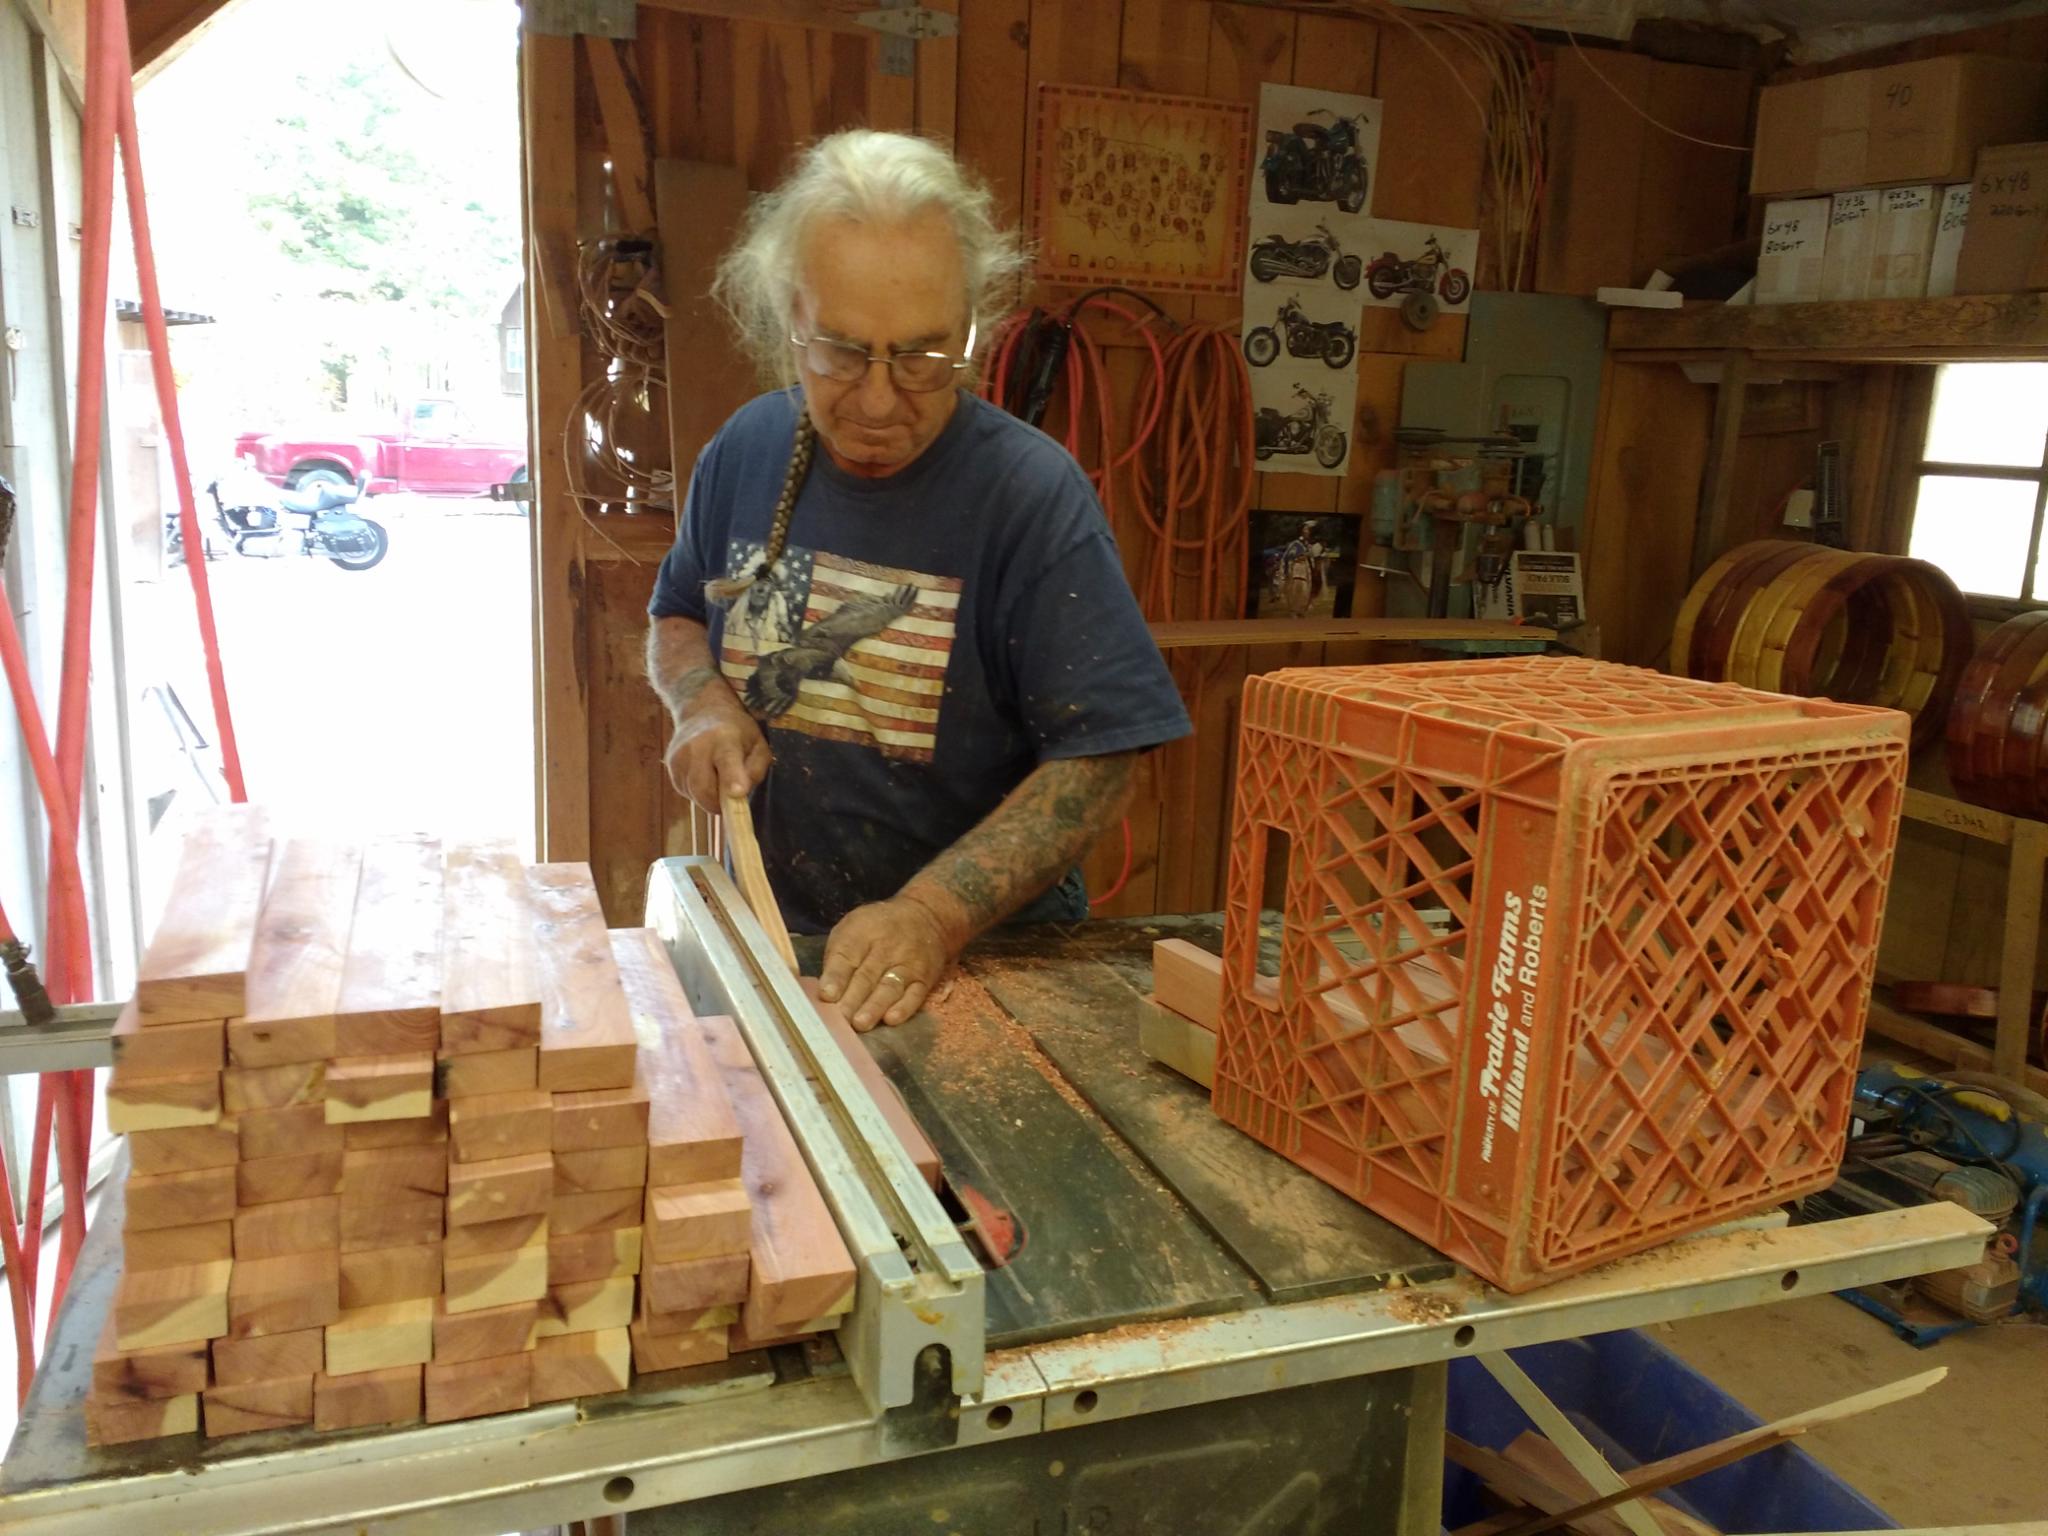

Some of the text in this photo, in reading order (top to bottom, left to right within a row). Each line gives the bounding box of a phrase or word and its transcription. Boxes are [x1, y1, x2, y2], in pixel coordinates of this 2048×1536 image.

[1886, 82, 1912, 110] 40
[1491, 890, 1522, 998] Farms
[1479, 1001, 1510, 1098] Prairie
[1500, 884, 1548, 1133] Hiland and Roberts
[1488, 1099, 1498, 1114] OF
